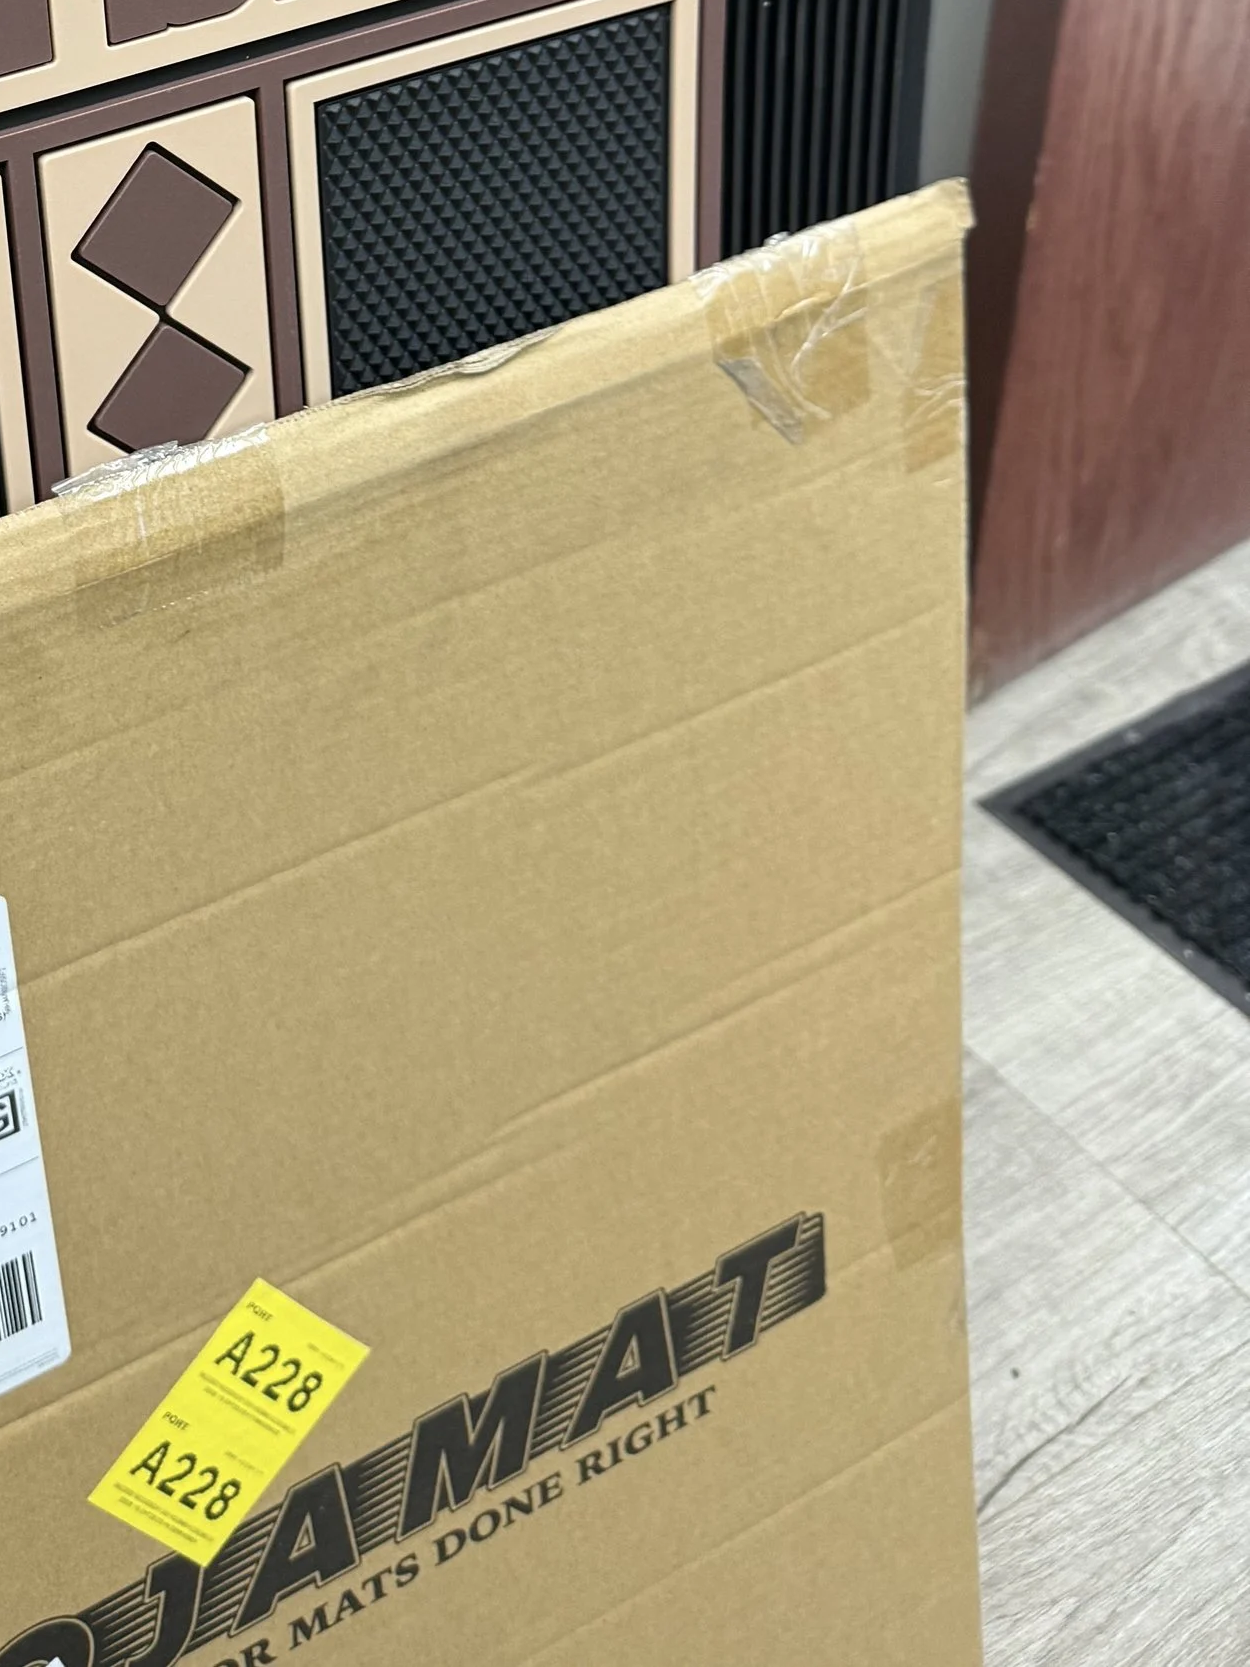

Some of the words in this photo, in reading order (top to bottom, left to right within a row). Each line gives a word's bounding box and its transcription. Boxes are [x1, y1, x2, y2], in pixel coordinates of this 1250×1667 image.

[213, 1330, 324, 1413] A228
[128, 1439, 242, 1521] A228
[288, 1552, 419, 1651] MATS
[433, 1470, 566, 1567] DONE
[576, 1385, 717, 1486] RIGHT
